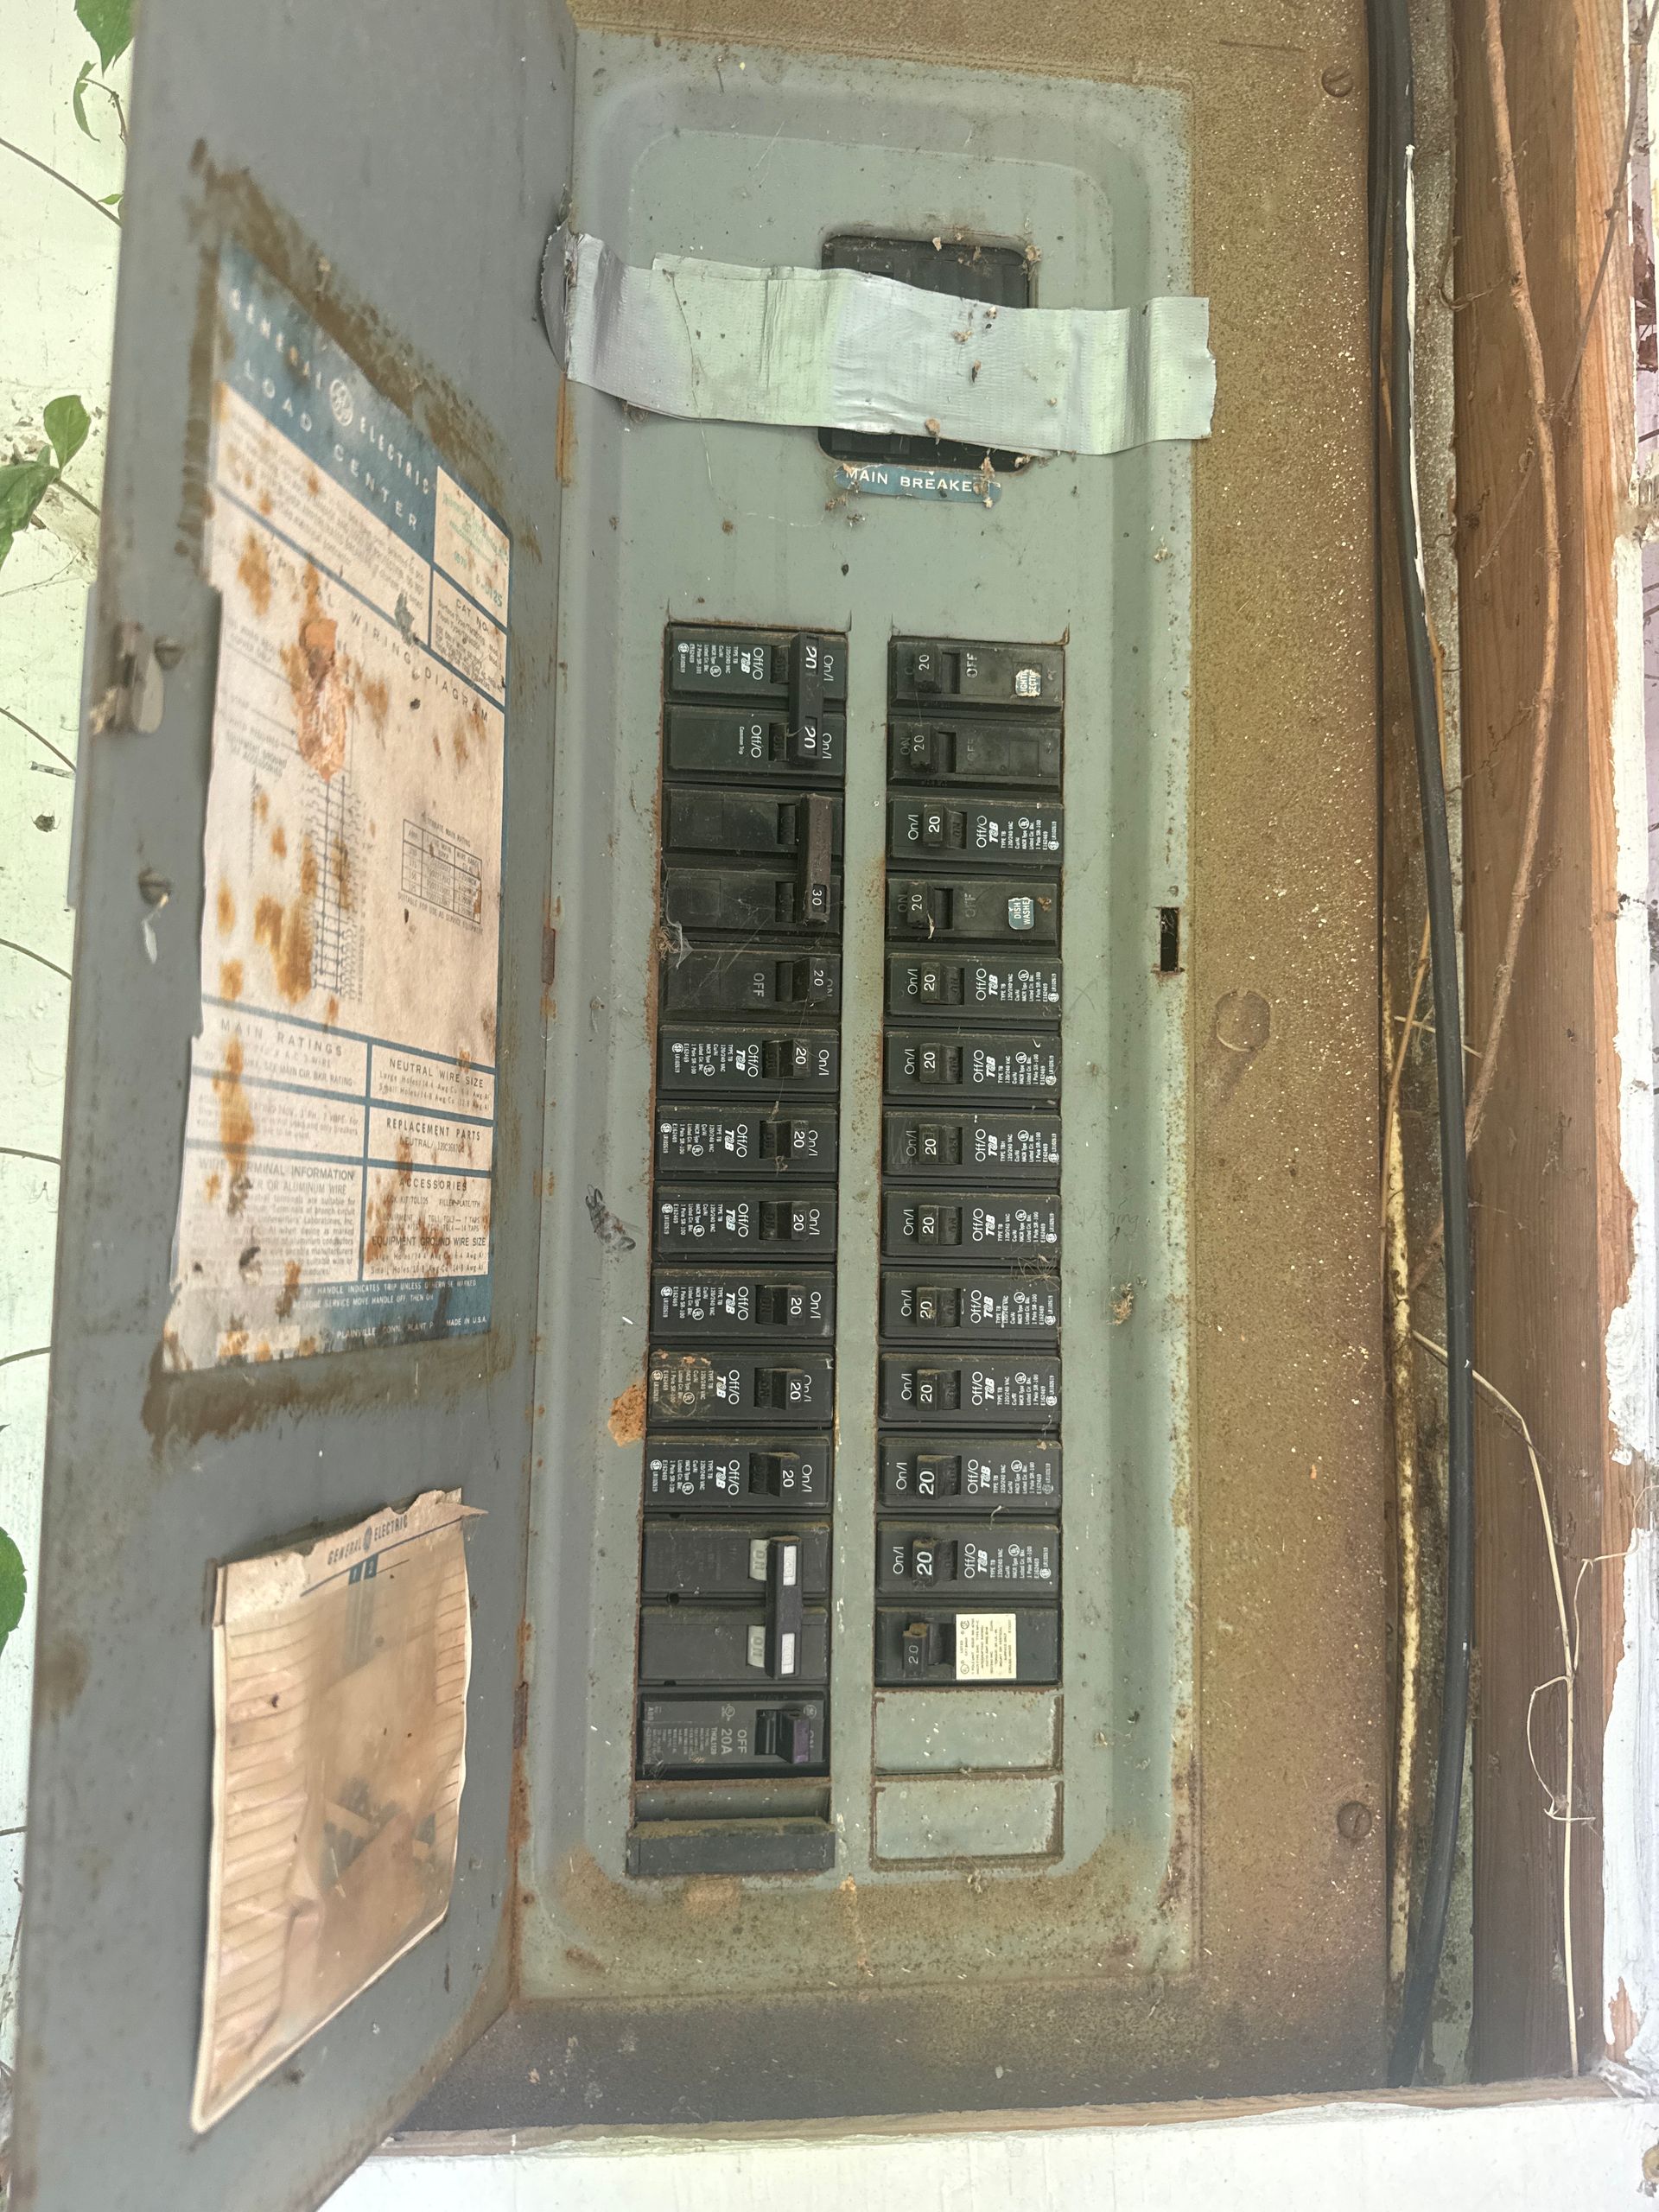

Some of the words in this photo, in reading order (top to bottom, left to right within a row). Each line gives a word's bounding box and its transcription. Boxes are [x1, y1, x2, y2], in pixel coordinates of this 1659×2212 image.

[244, 359, 312, 432] LOAD
[334, 443, 417, 531] CENTER
[359, 415, 429, 495] ELECTRIC
[846, 470, 888, 484] MAIN
[899, 476, 979, 493] BREAKE
[351, 610, 410, 664] WIRING
[424, 666, 487, 721] DIAGRAM
[753, 647, 764, 680] Off/O
[918, 654, 930, 671] 20
[966, 652, 977, 678] OFF
[751, 725, 762, 758] Off/O
[913, 734, 925, 752] 20
[928, 816, 940, 833] 20
[976, 816, 987, 848] Off/O
[812, 889, 823, 906] 30
[912, 894, 922, 912] 20
[753, 972, 765, 997] OFF
[814, 970, 823, 986] 20
[924, 974, 935, 991] 20
[976, 968, 987, 1001] Off/O
[221, 1019, 263, 1039] MAIN
[277, 1032, 342, 1057] RATINGS
[747, 1044, 759, 1077] Off/O
[795, 1047, 806, 1065] 20
[925, 1052, 936, 1069] 20
[973, 1049, 984, 1083] Off/O
[389, 1058, 433, 1077] NEUTRAL
[439, 1070, 460, 1084] WIRE
[466, 1076, 483, 1088] SIZE
[387, 1117, 449, 1137] REPLACEMENT
[456, 1128, 480, 1141] PARTS
[736, 1123, 747, 1158] Off/O
[794, 1131, 805, 1148] 20
[925, 1138, 937, 1155] 20
[975, 1128, 986, 1161] Off/O
[292, 1165, 354, 1181] INFORMATION
[399, 1178, 467, 1192] ACCESSORIES
[738, 1203, 748, 1237] Off/O
[793, 1214, 804, 1231] 20
[923, 1217, 935, 1234] 20
[972, 1208, 983, 1241] Off/O
[372, 1236, 416, 1248] EQUIPMENT
[453, 1237, 468, 1246] WIRE
[472, 1237, 486, 1246] SIZE
[347, 1284, 379, 1294] INDICATES
[737, 1287, 748, 1320] Off/O
[791, 1297, 802, 1315] 20
[920, 1300, 932, 1319] 20
[970, 1289, 982, 1323] Off/O
[728, 1370, 740, 1405] Off/O
[790, 1382, 801, 1401] 20
[920, 1384, 932, 1403] 20
[972, 1371, 983, 1405] Off/O
[728, 1460, 740, 1495] Off/O
[783, 1469, 794, 1487] 20
[919, 1471, 935, 1495] 20
[968, 1459, 979, 1494] Off/O
[374, 1515, 408, 1541] ELECTRIC
[916, 1551, 932, 1575] 20
[964, 1543, 976, 1578] Off/O
[908, 1645, 918, 1664] 20
[721, 1729, 733, 1754] 20A
[737, 1729, 747, 1753] OFF
